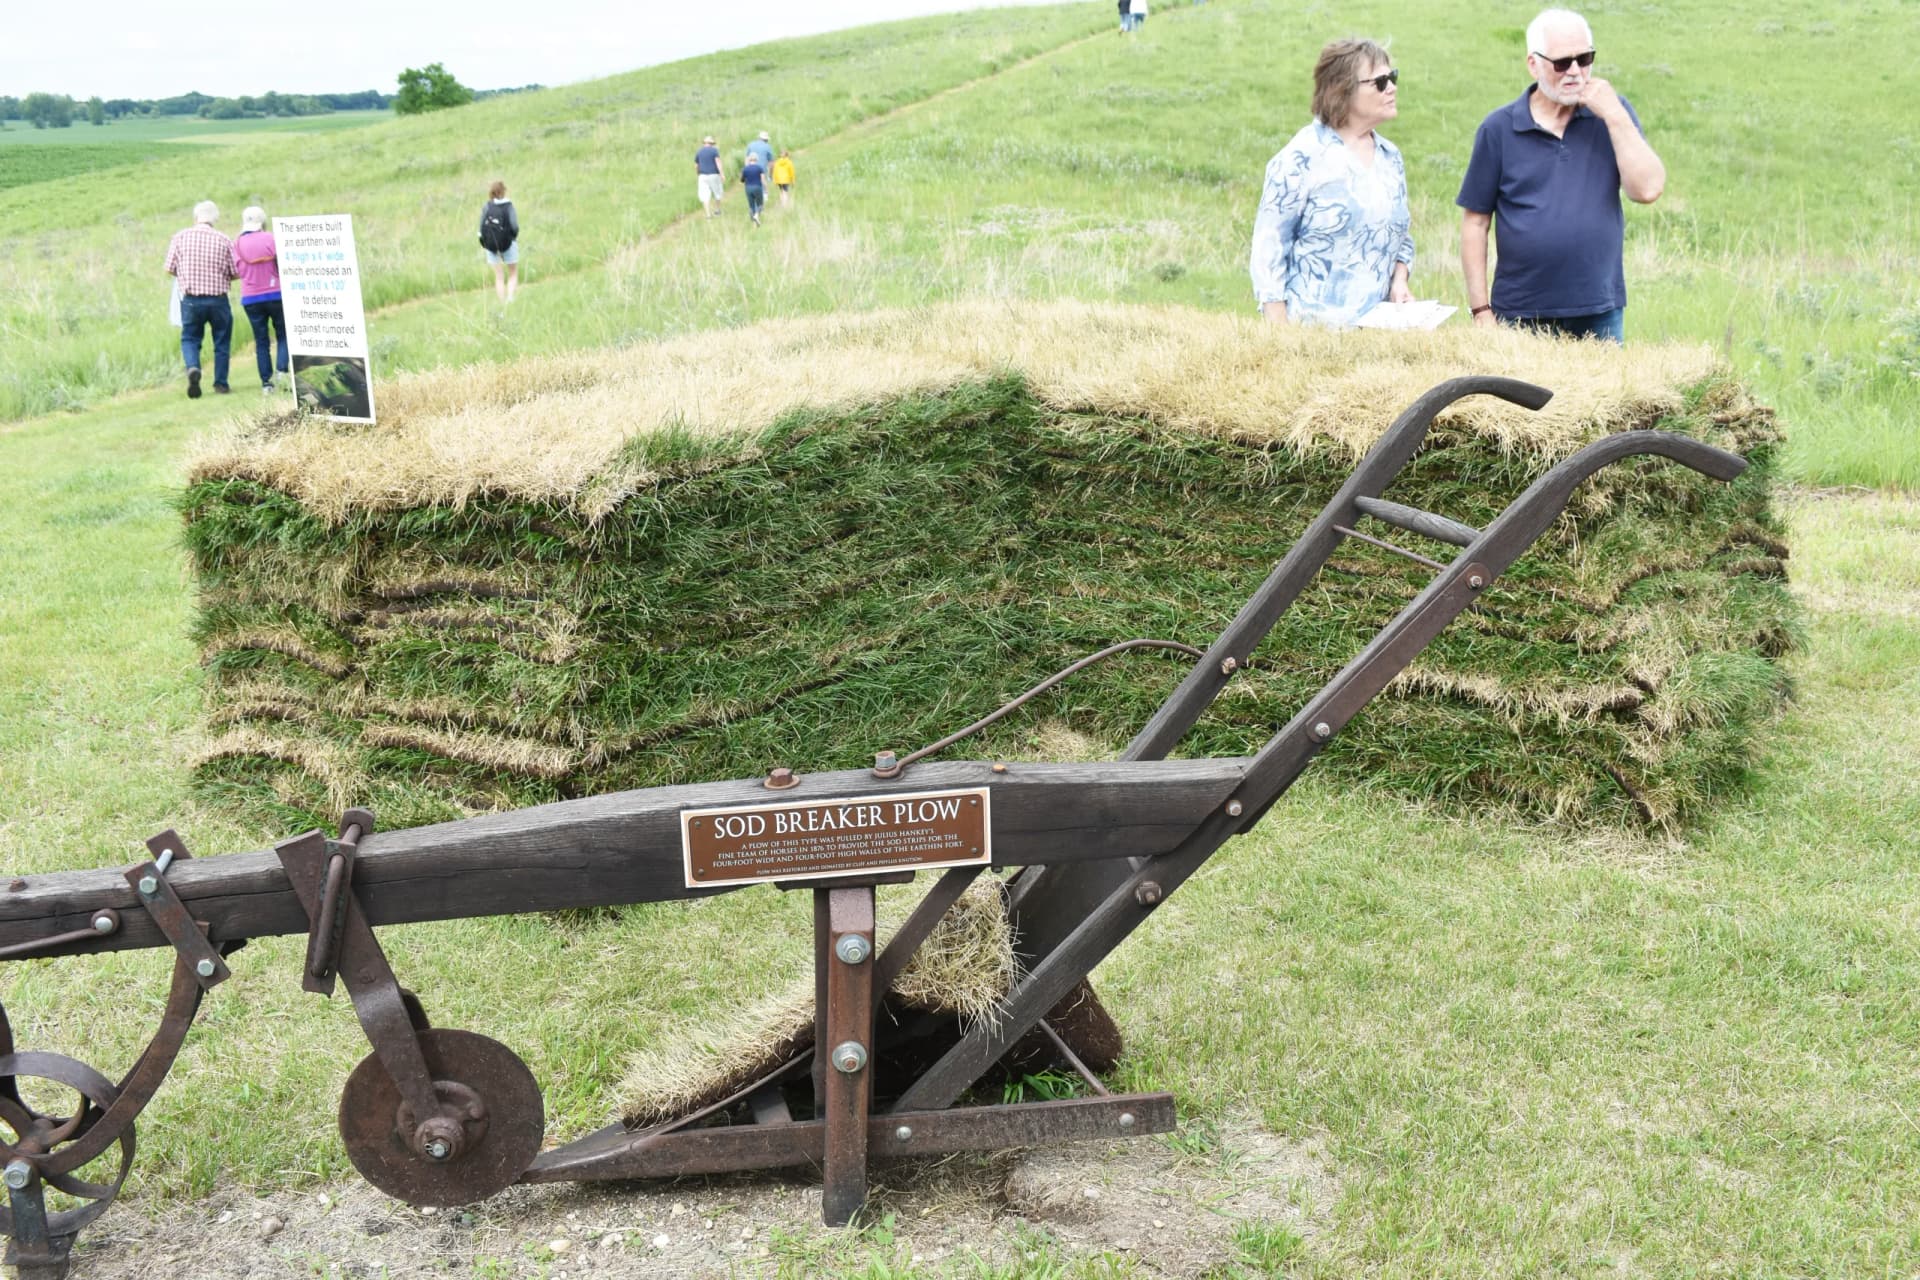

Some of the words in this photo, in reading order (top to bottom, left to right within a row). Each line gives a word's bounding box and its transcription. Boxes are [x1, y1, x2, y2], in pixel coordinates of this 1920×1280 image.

[280, 222, 294, 232] The
[296, 222, 323, 232] settlers
[326, 220, 342, 231] built
[284, 239, 294, 247] an
[296, 238, 324, 246] earthen
[326, 236, 340, 246] wall
[282, 267, 303, 276] which
[306, 266, 340, 276] enclosed
[342, 266, 352, 276] an
[303, 296, 310, 304] to
[312, 295, 336, 304] defend
[300, 310, 344, 320] themselves
[294, 324, 320, 335] against
[322, 325, 355, 334] rumored
[714, 815, 766, 839] SOD
[774, 805, 886, 834] BREAKER
[894, 798, 962, 824] PLOW
[900, 828, 934, 837] HANKEY'S
[770, 847, 797, 855] HORSES
[838, 841, 868, 849] PROVIDE
[713, 859, 753, 868] FOUR-FOOT
[795, 852, 836, 861] FOUR-FOOT
[910, 842, 943, 851] EARTHEN
